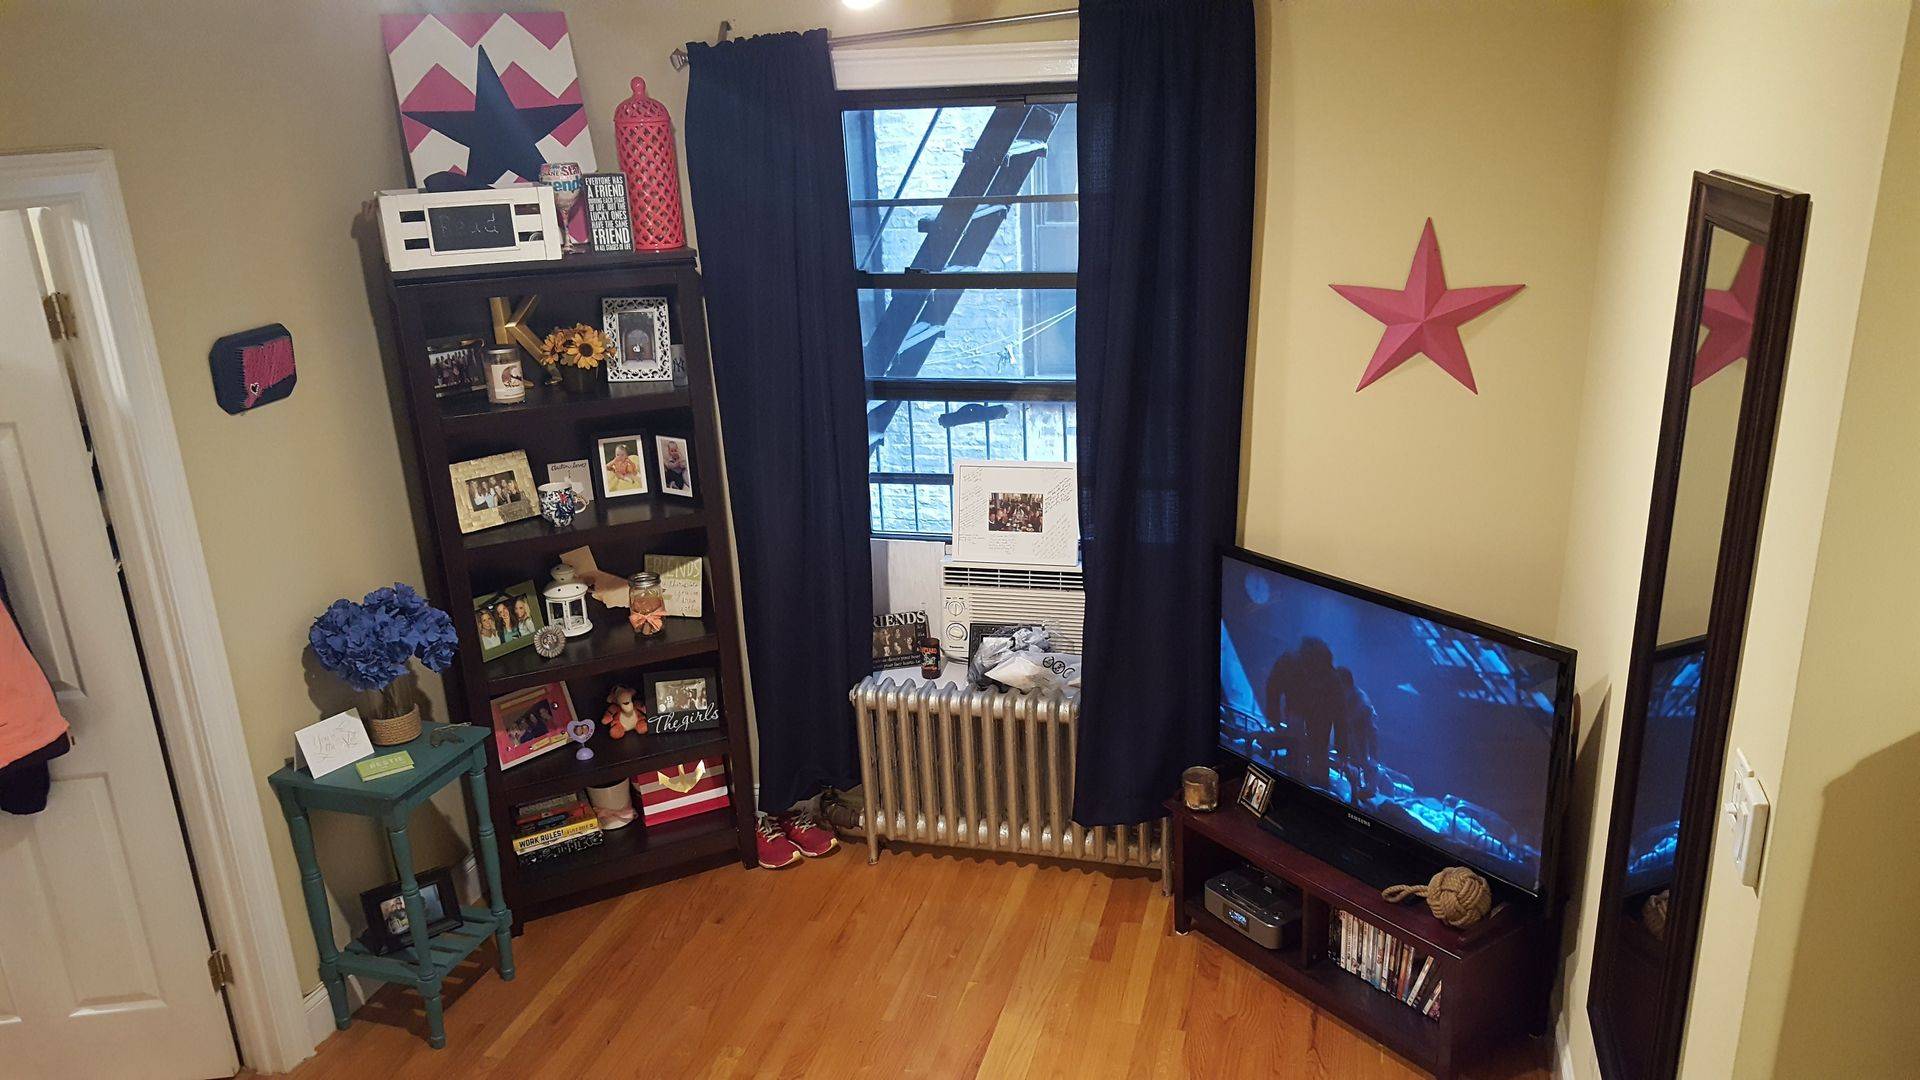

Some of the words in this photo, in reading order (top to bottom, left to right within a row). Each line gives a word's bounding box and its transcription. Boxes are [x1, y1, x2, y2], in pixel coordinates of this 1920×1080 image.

[586, 177, 611, 185] EVERYONE
[588, 185, 593, 198] A
[595, 185, 625, 198] FRIEND
[590, 211, 609, 221] LUCKY
[611, 211, 628, 220] ONES
[592, 221, 604, 229] HAVE
[605, 220, 614, 228] THE
[615, 220, 629, 228] SAME
[593, 228, 631, 245] FRIEND
[518, 836, 540, 849] WORK
[541, 829, 564, 842] RULES!
